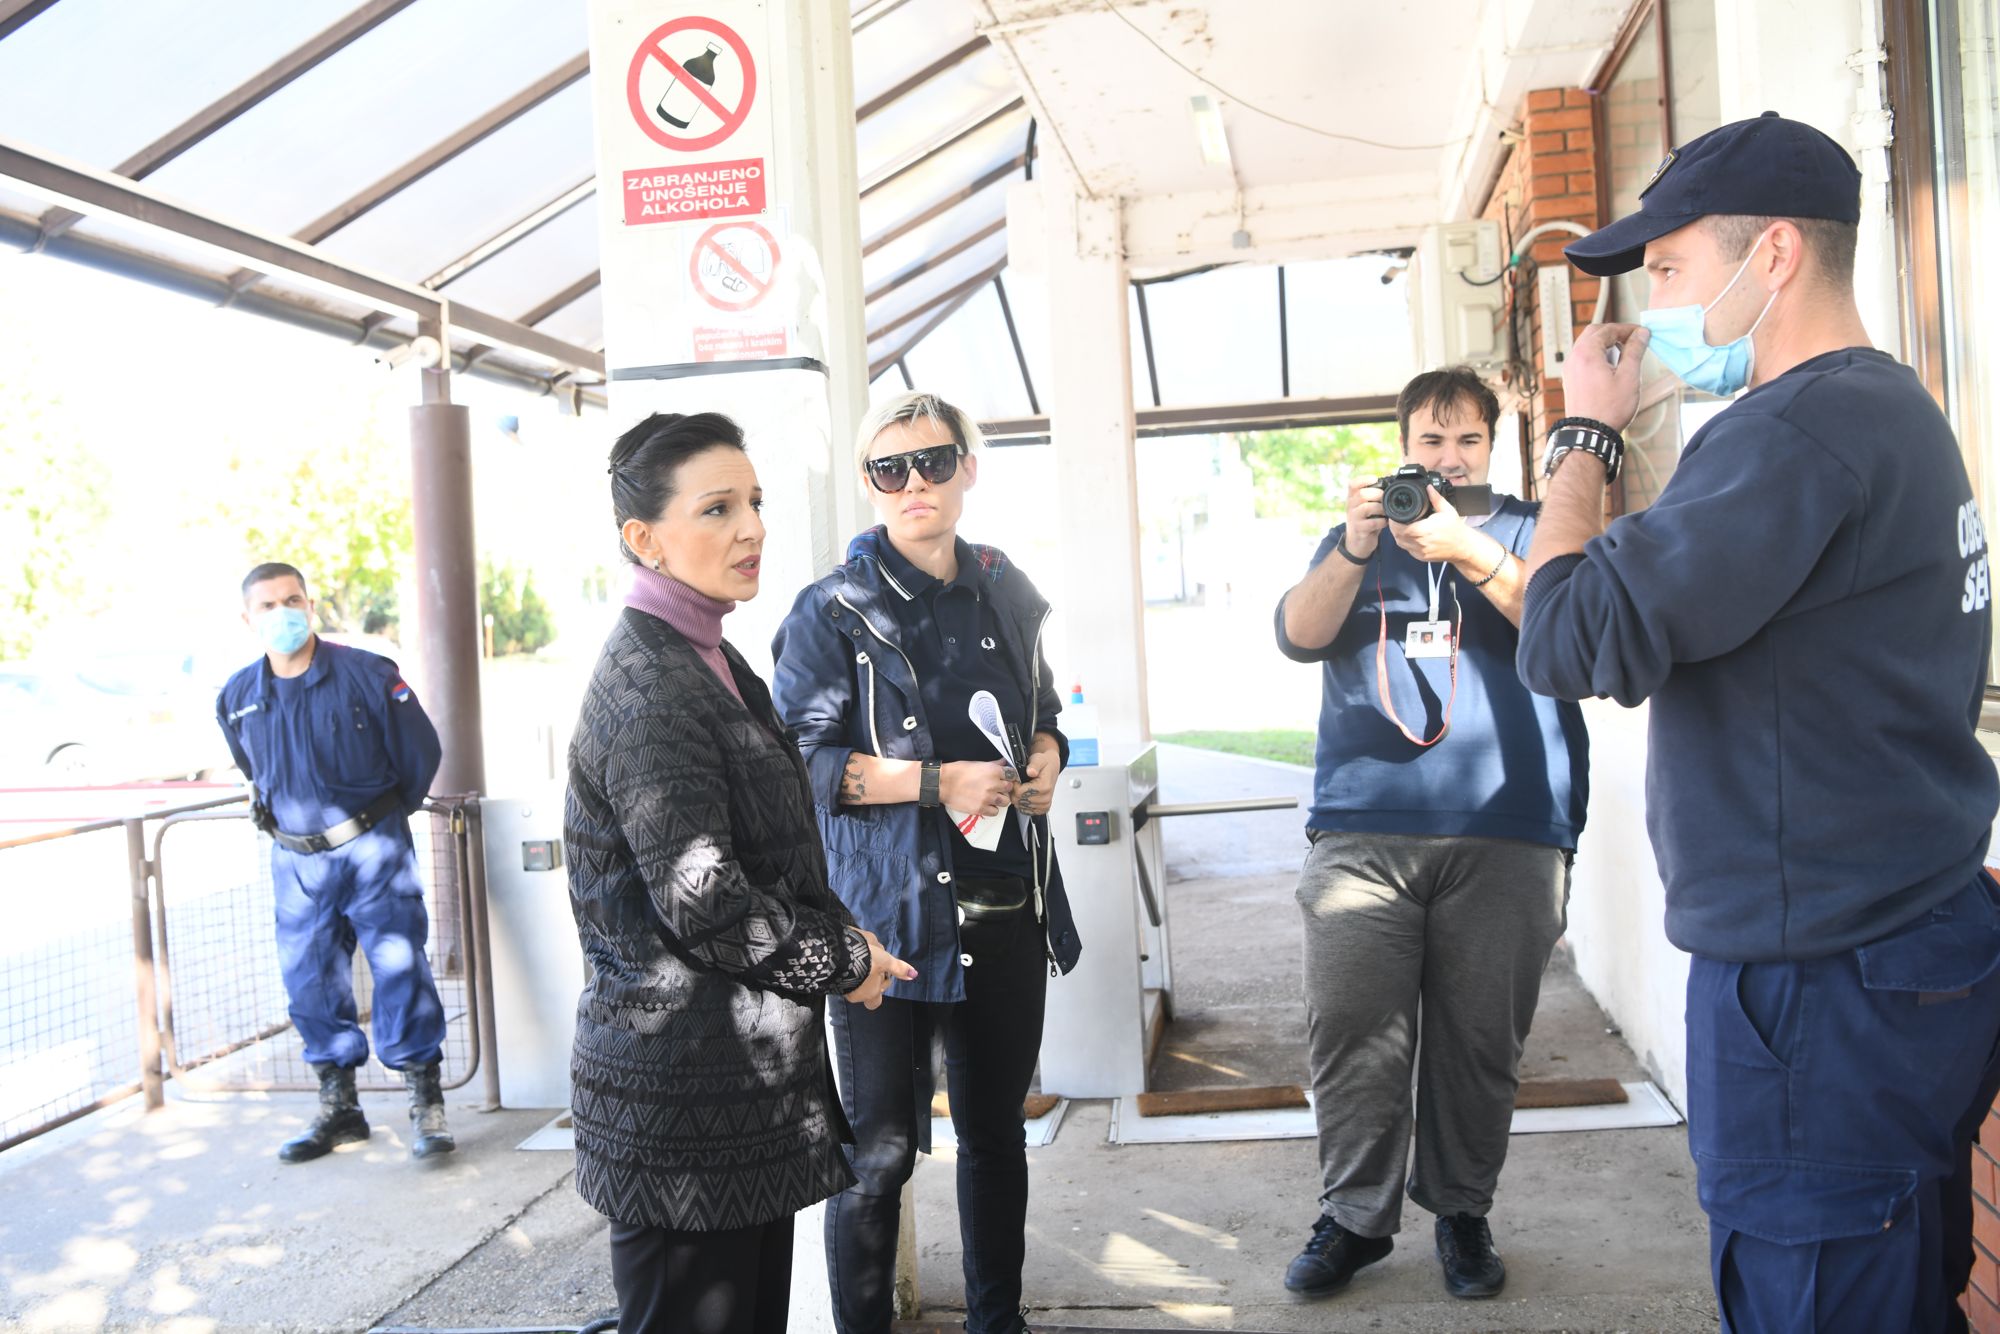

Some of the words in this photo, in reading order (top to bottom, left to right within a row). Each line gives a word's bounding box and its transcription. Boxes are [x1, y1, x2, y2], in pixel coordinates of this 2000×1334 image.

[627, 167, 761, 190] ZABRANJENO
[642, 182, 748, 202] UNOŠENJE
[641, 195, 750, 216] ALKOHOLA
